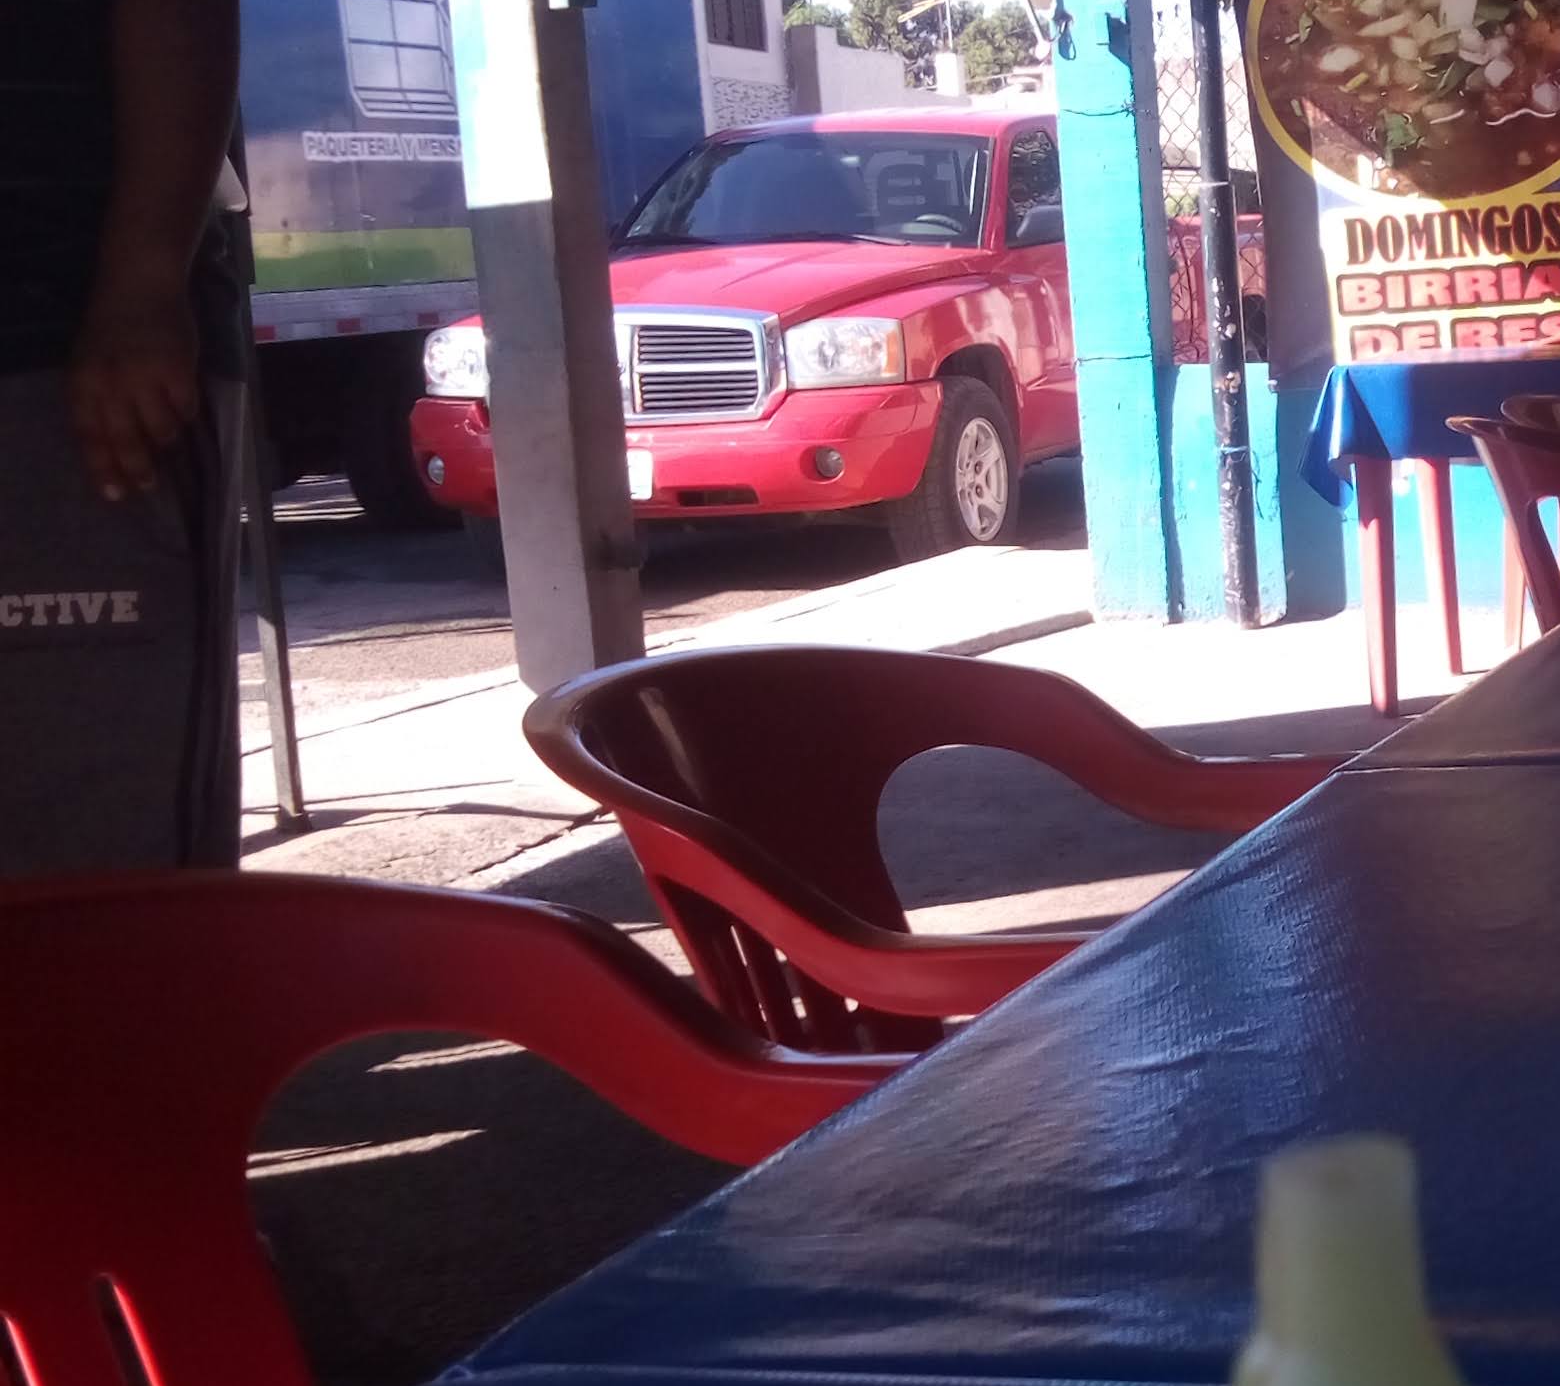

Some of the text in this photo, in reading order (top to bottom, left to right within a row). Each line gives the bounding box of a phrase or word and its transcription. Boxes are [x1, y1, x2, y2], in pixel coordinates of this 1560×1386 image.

[304, 132, 461, 161] PAQUETERIA Y MENS
[1351, 320, 1442, 361] DE
